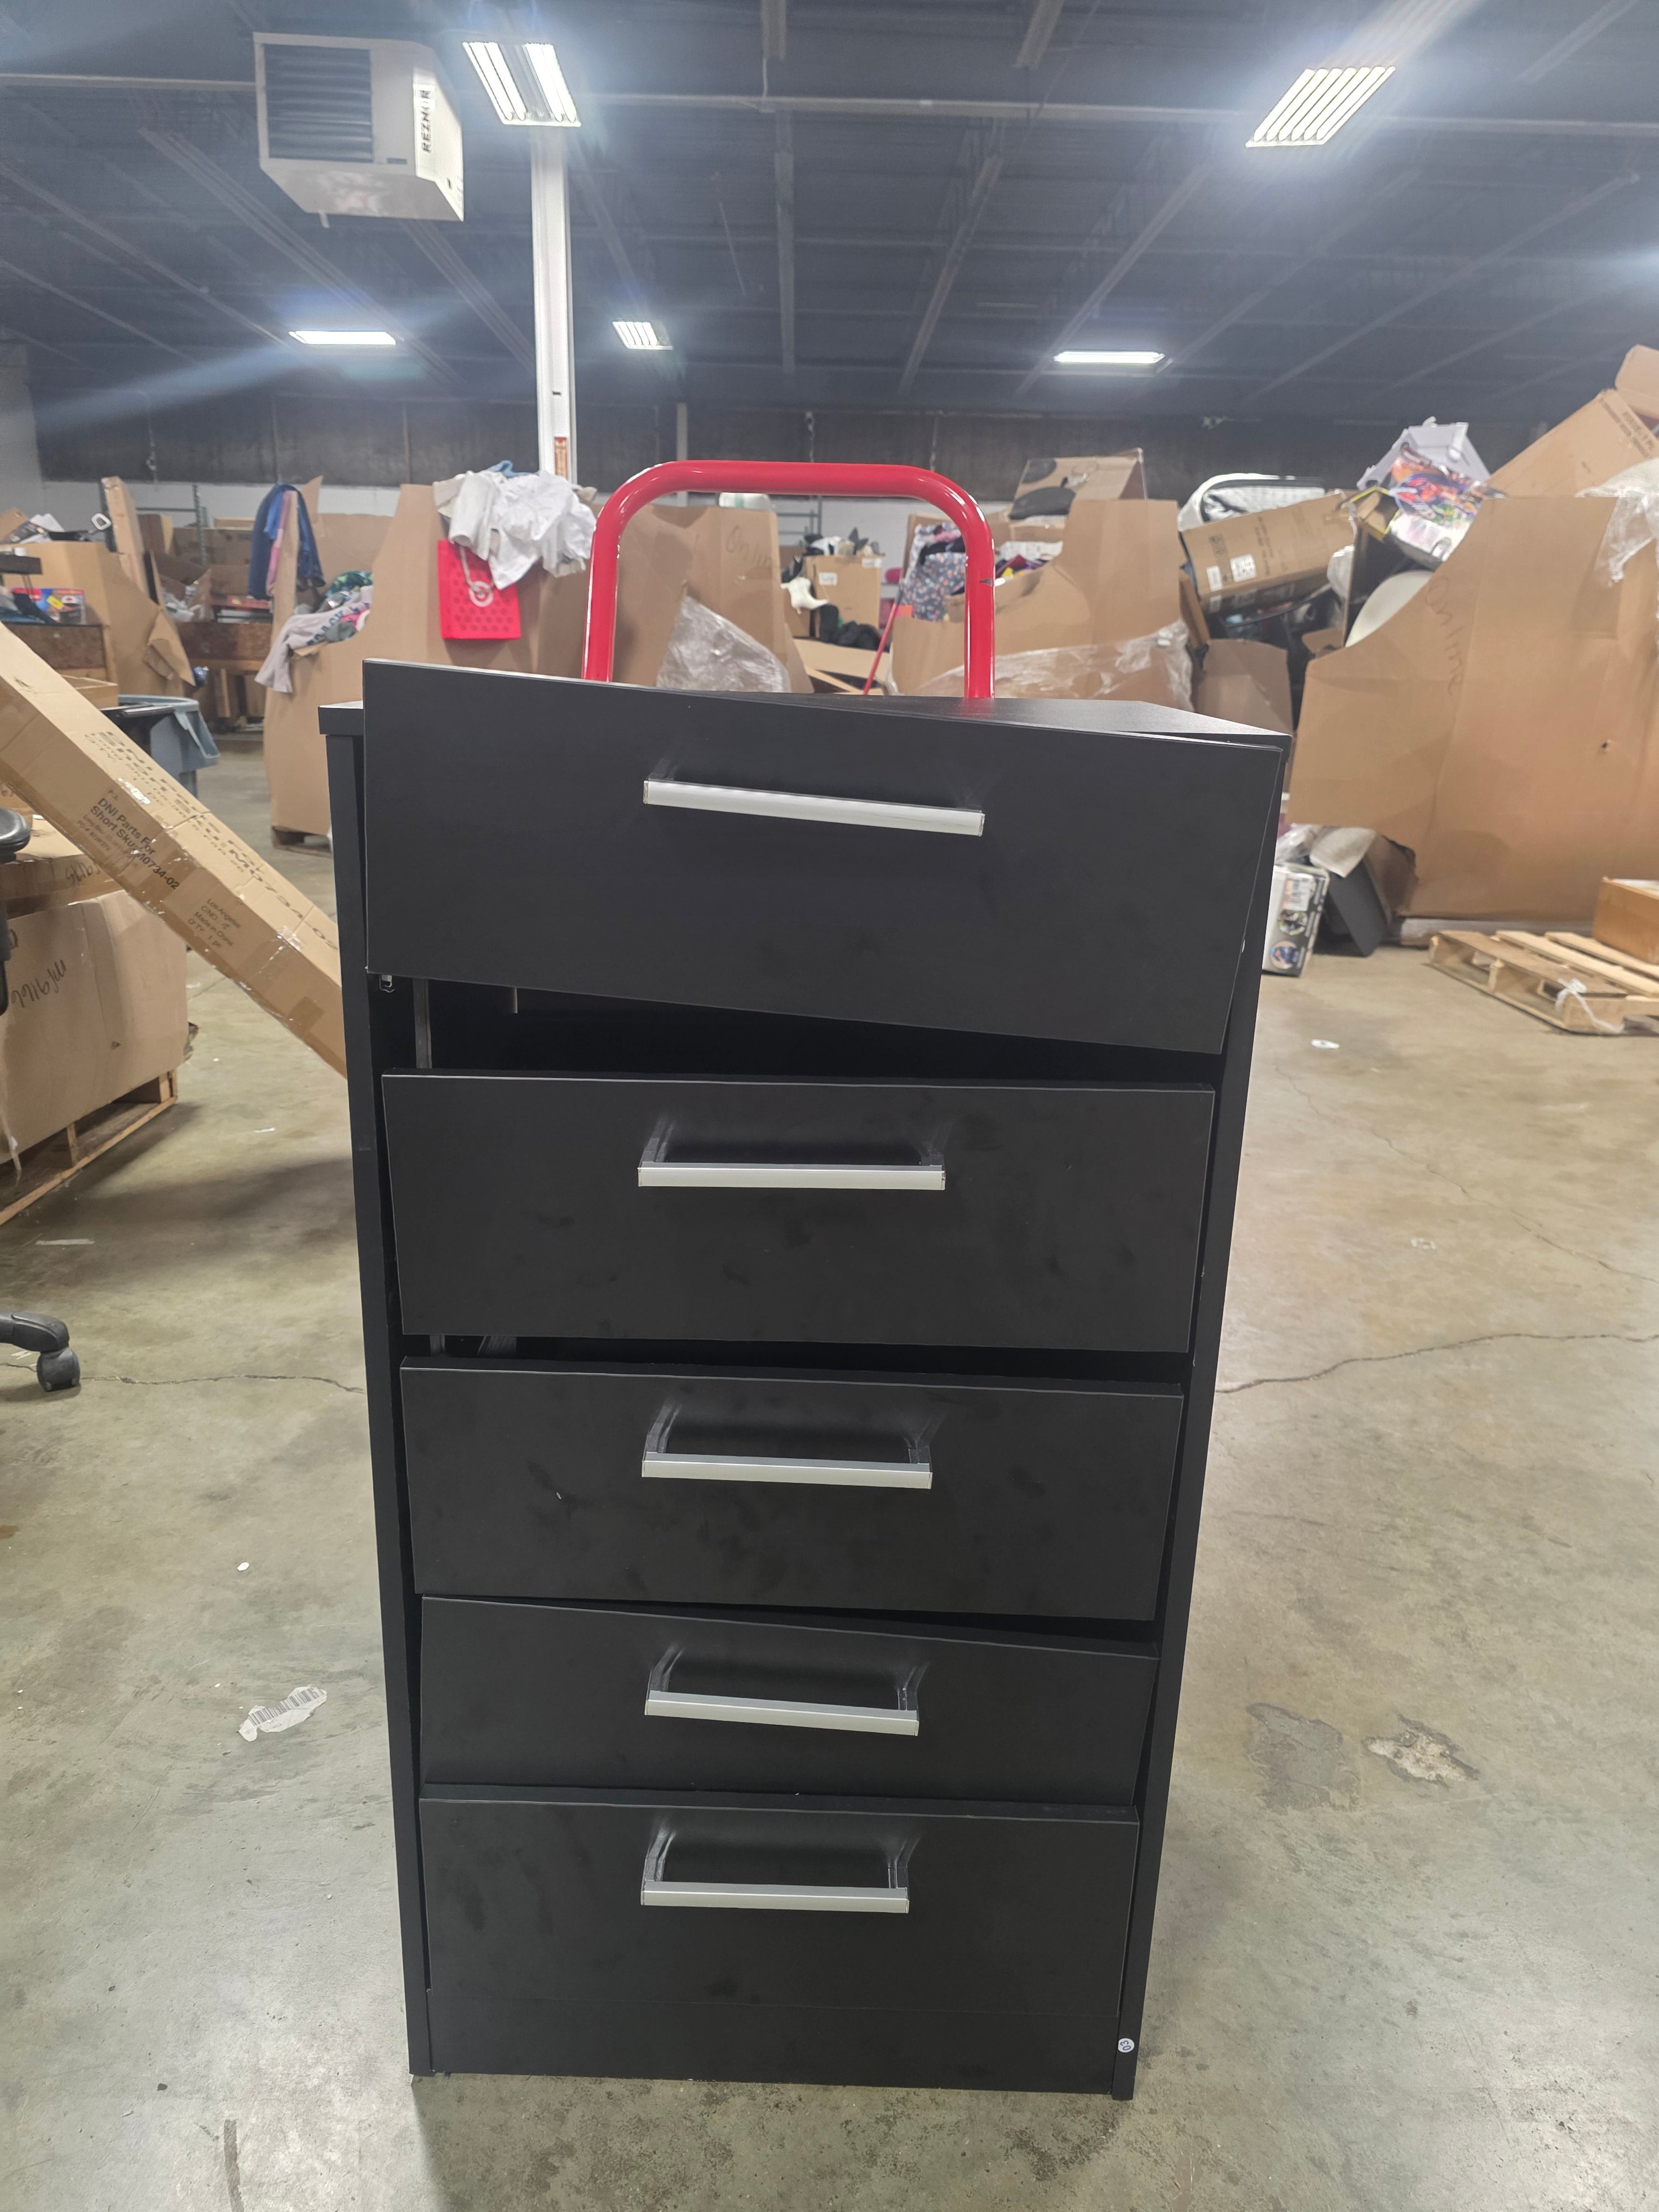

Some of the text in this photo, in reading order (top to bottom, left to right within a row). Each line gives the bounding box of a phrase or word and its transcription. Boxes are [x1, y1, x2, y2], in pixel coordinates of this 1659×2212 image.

[420, 90, 432, 154] REZNOR
[90, 806, 117, 831] Short
[97, 798, 118, 816] DNI
[117, 815, 142, 839] Parts
[140, 837, 155, 855] For
[194, 911, 210, 927] Made
[216, 931, 233, 946] China
[207, 898, 241, 929] Los Angeles
